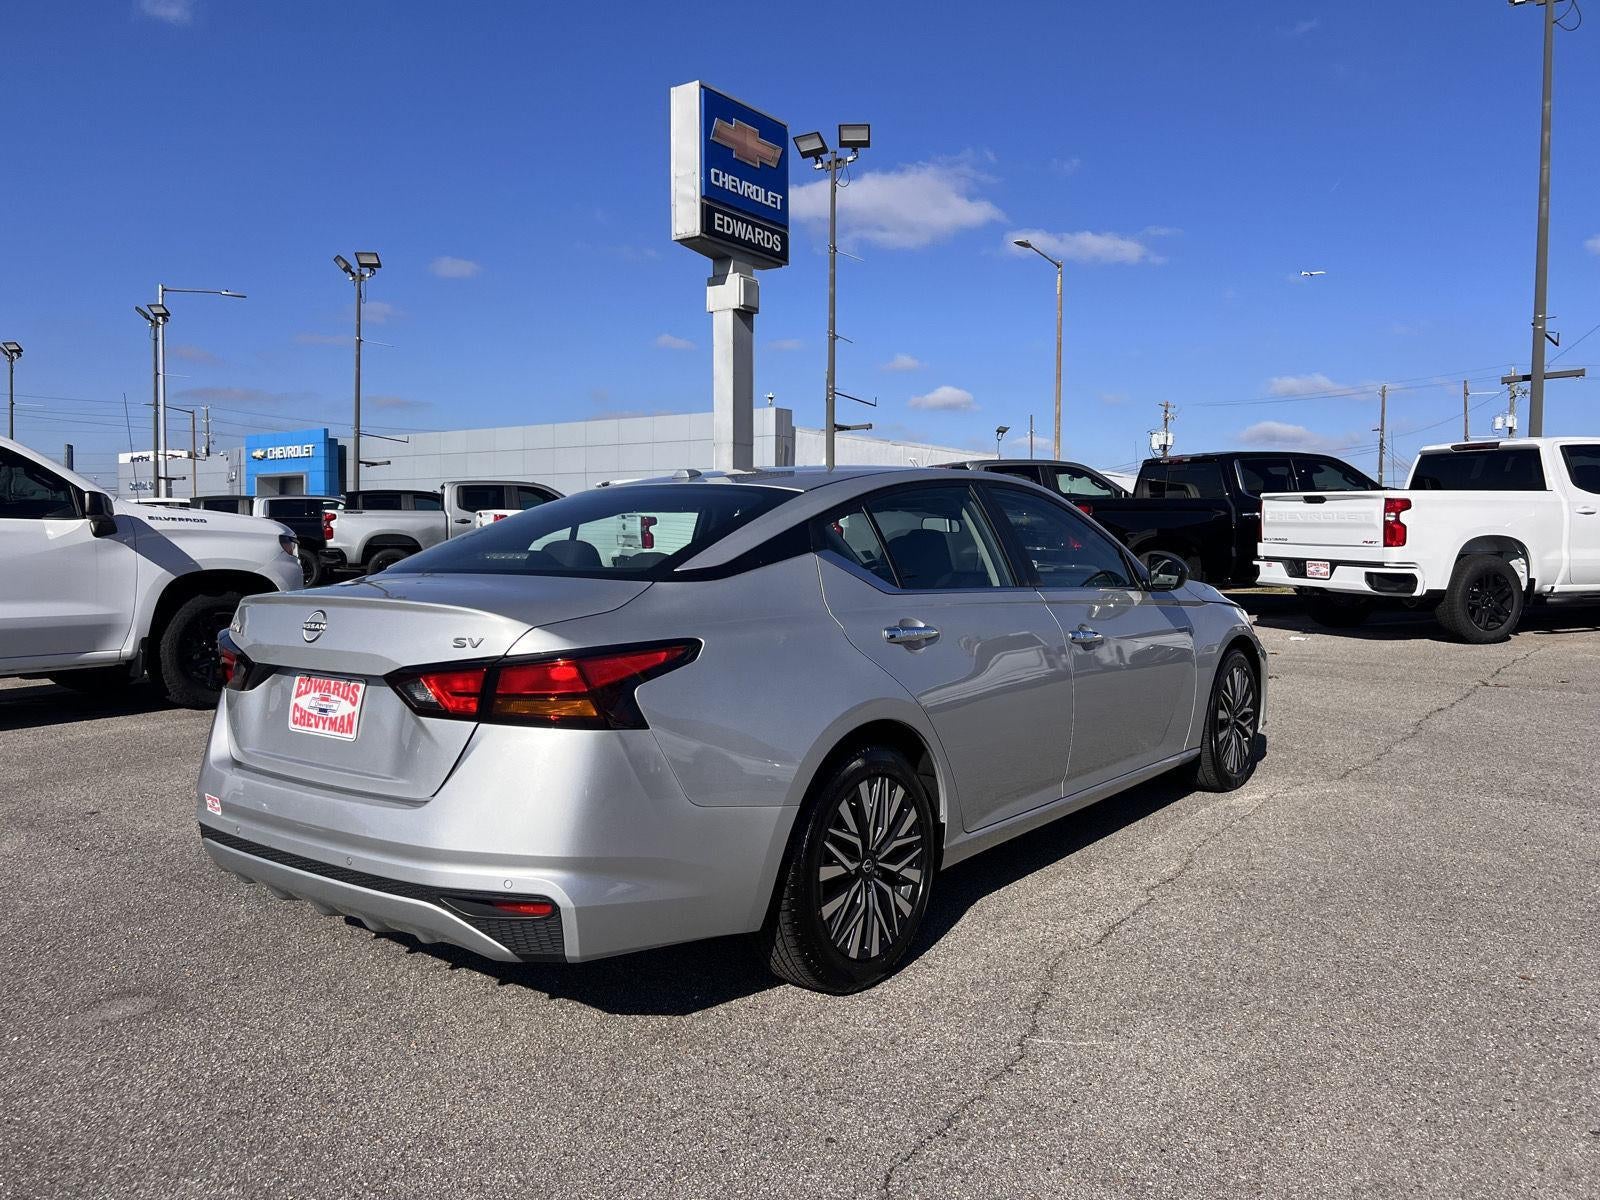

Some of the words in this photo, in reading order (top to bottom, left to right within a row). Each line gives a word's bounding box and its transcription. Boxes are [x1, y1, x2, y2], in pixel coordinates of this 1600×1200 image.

[710, 167, 783, 210] CHEVROLET
[714, 212, 782, 252] EDWARDS
[267, 444, 314, 460] CHEVROLET
[147, 515, 208, 523] SILVERADO
[1265, 509, 1371, 522] CHEVROLET
[303, 622, 327, 631] NISSAN
[453, 637, 484, 648] SV
[295, 677, 360, 707] EDWARDS
[292, 702, 356, 735] CHEVYMAN
